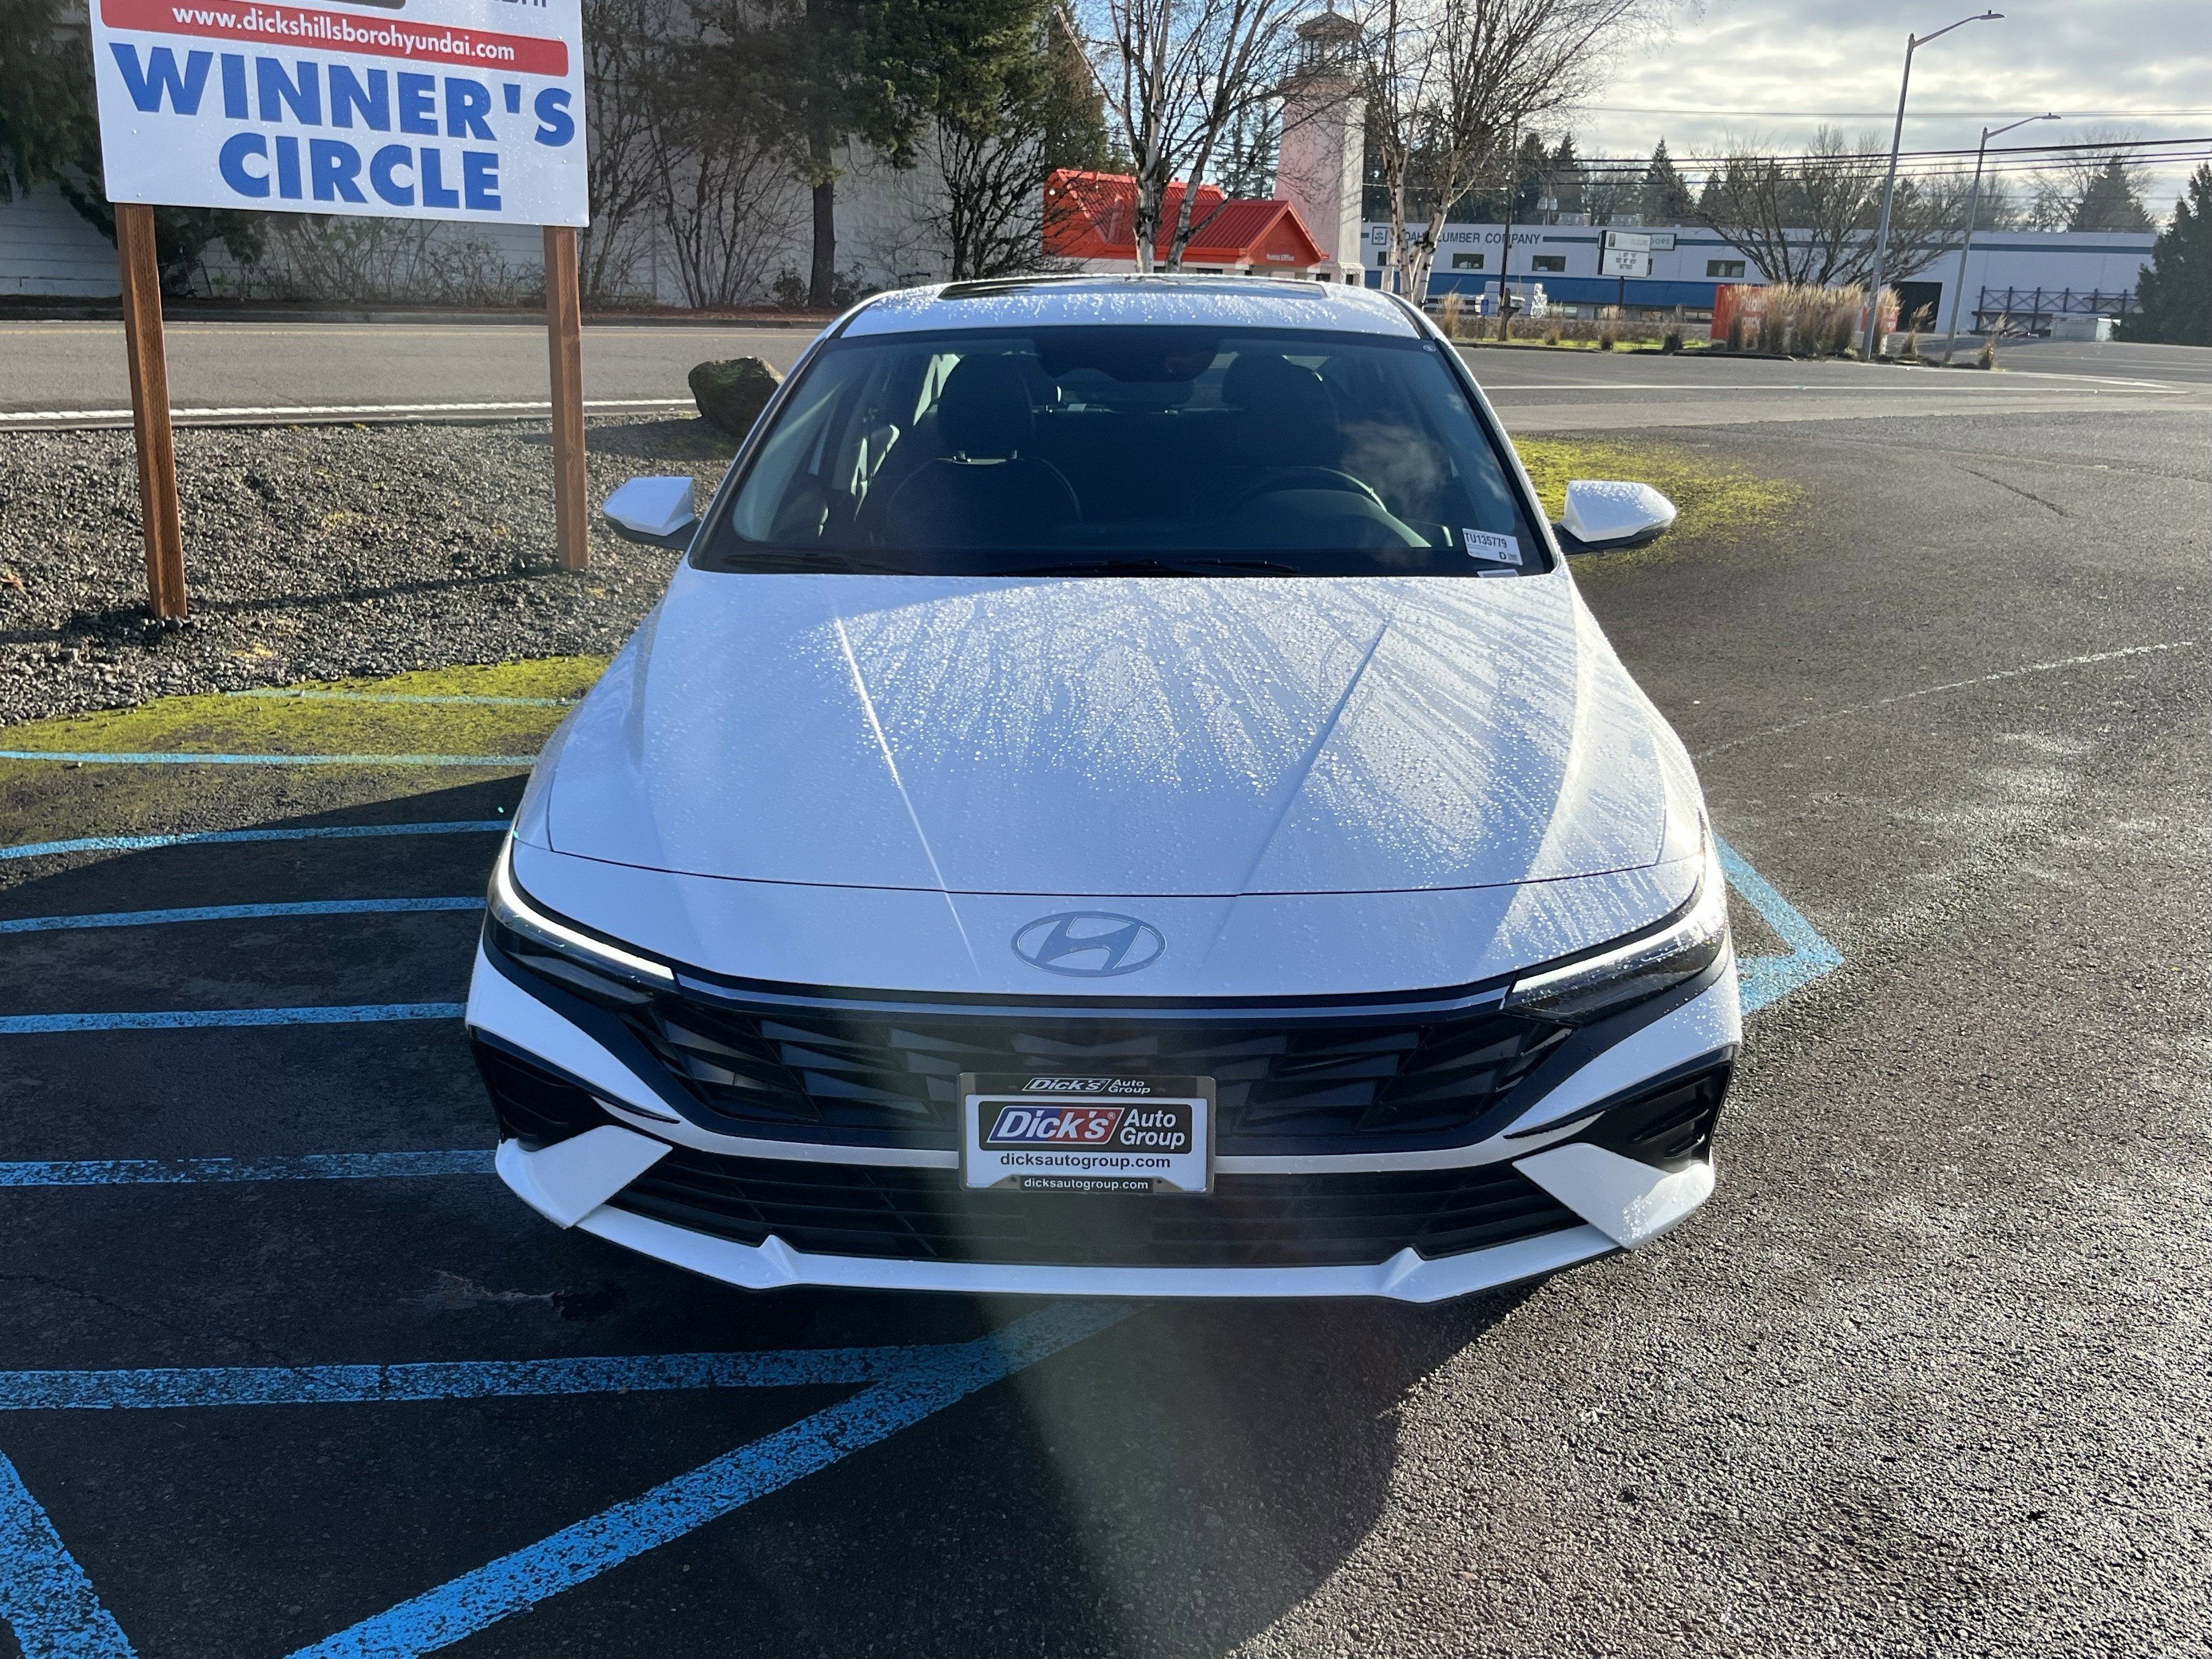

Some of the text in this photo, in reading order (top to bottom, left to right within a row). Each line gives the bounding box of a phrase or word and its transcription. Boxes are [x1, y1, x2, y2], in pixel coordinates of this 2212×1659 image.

[171, 7, 515, 61] www.dickshillsborohyundai.com
[109, 42, 575, 148] WINNER'S
[219, 132, 502, 212] CIRCLE
[1463, 532, 1507, 548] TU135779
[1029, 1079, 1102, 1091] Dick's
[1108, 1086, 1151, 1094] Group
[996, 1109, 1177, 1139] Dick's Auto
[1120, 1127, 1185, 1150] Group
[1001, 1153, 1170, 1170] dicksautogroup.com
[1024, 1177, 1148, 1190] dicksautogroup.com
